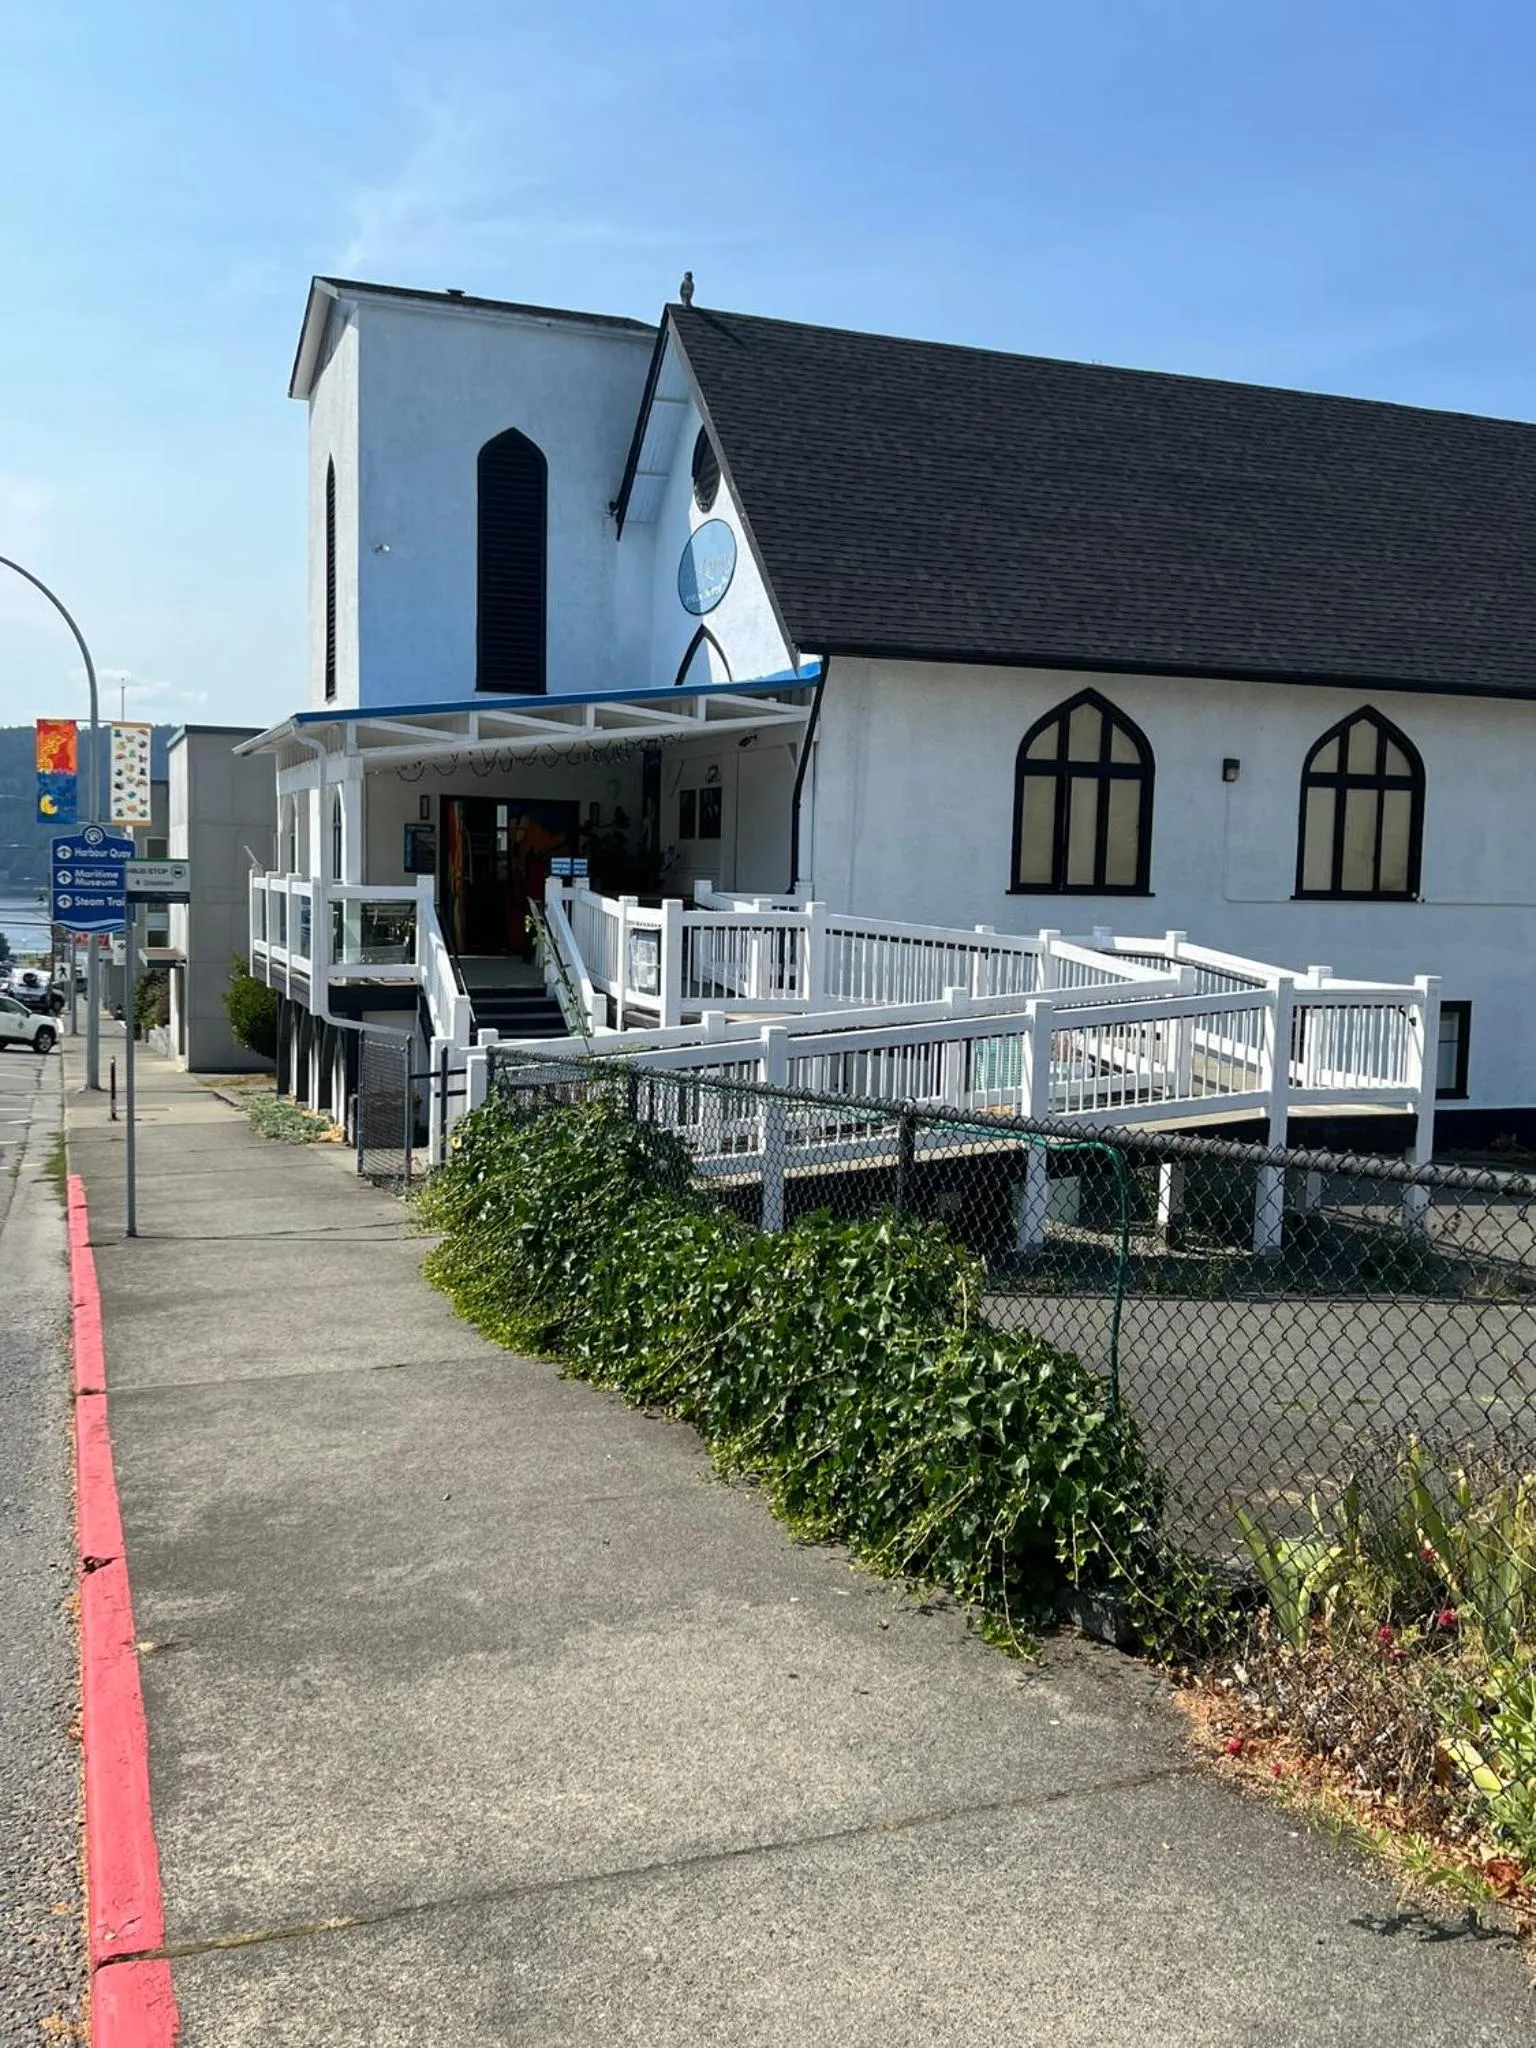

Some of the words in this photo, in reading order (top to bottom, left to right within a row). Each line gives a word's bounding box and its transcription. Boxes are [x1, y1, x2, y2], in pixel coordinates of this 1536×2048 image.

[75, 848, 108, 858] Harbour
[109, 849, 131, 858] Quay
[75, 869, 119, 878] Maritime
[75, 879, 117, 887] Museum
[75, 897, 104, 906] Steam
